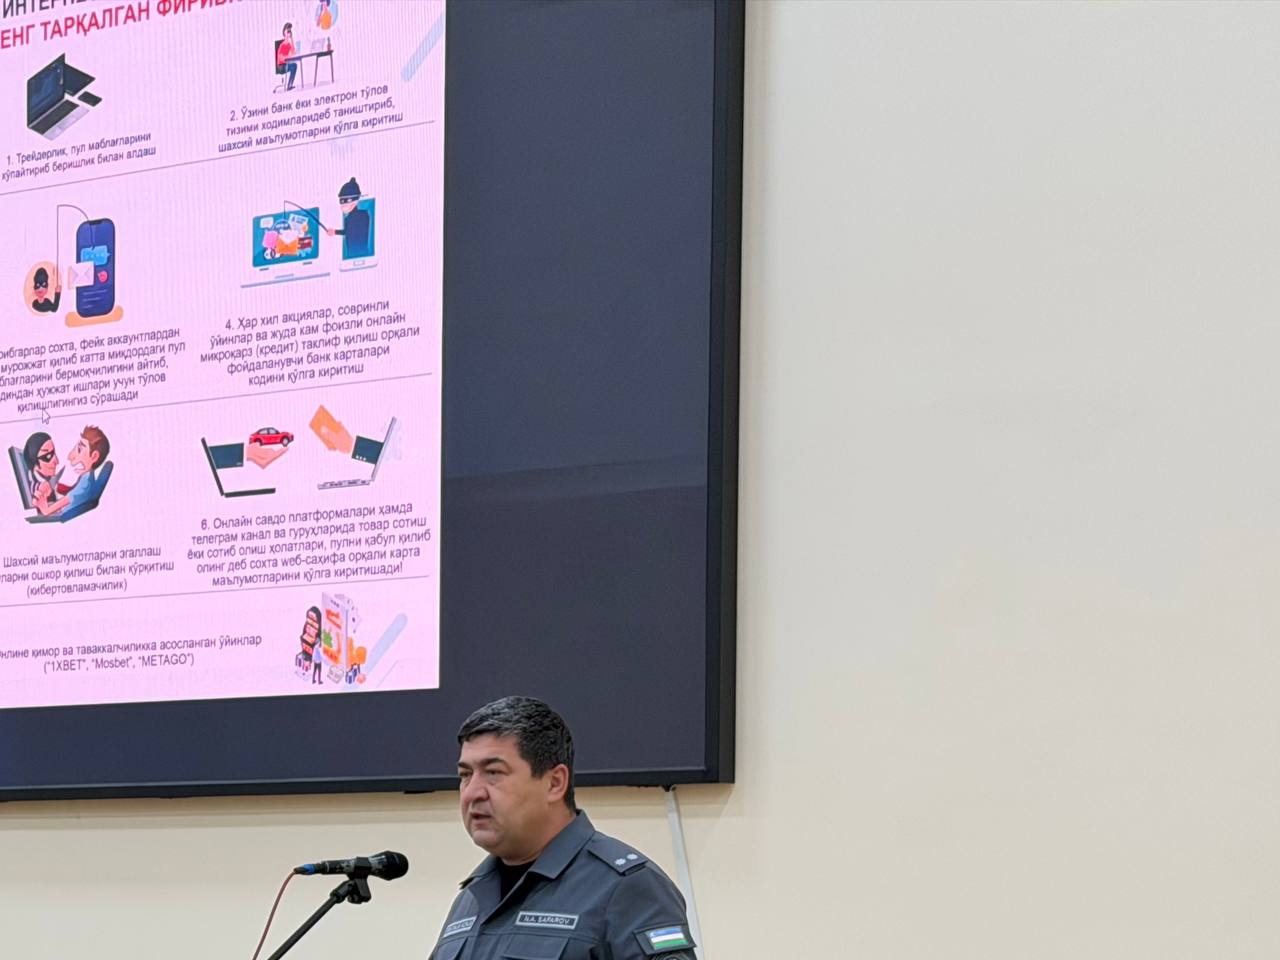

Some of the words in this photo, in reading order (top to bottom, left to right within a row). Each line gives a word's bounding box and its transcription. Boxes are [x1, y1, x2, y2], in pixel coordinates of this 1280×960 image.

[40, 1, 150, 41] ТАРҚАЛГАН
[229, 109, 238, 121] 2.
[240, 105, 268, 119] Ўзини
[271, 102, 293, 113] банк
[314, 90, 357, 106] электрон
[360, 84, 388, 99] тўлов
[218, 136, 252, 152] шахсий
[255, 125, 330, 145] маълумотларни
[333, 120, 358, 134] қўлга
[361, 112, 403, 128] киритиш
[225, 123, 259, 136] тизими
[261, 107, 330, 130] ходимларидеб
[6, 154, 13, 165] 1.
[70, 143, 86, 155] пул
[97, 152, 124, 164] билан
[126, 146, 156, 159] алдаш
[224, 318, 234, 330] 4.
[236, 316, 257, 330] Ҳар
[260, 314, 278, 326] хил
[337, 300, 389, 316] совринли
[255, 330, 267, 341] ва
[270, 327, 296, 341] жуда
[299, 324, 319, 335] кам
[322, 318, 363, 334] фоизли
[365, 311, 405, 327] онлайн
[79, 335, 104, 351] фейк
[106, 328, 180, 345] аккаунтлардан
[79, 351, 105, 363] катта
[167, 341, 185, 354] пул
[200, 347, 252, 363] микроқарз
[255, 339, 298, 358] (кредит)
[301, 334, 340, 349] таклиф
[343, 332, 378, 346] қилиш
[380, 326, 420, 341] орқали
[226, 356, 303, 375] фойдаланувчи
[306, 351, 331, 364] банк
[333, 345, 390, 361] карталари
[72, 379, 110, 392] ишлари
[112, 376, 135, 390] учун
[137, 372, 166, 386] тўлов
[248, 373, 284, 386] кодини
[287, 368, 315, 383] қўлга
[318, 363, 363, 379] киритиш
[200, 518, 210, 530] 6.
[213, 515, 252, 529] Онлайн
[255, 513, 286, 525] савдо
[288, 506, 375, 522] платформалари
[378, 502, 412, 515] ҳамда
[191, 533, 238, 545] телеграм
[240, 529, 271, 541] канал
[273, 528, 286, 538] ва
[358, 519, 389, 531] товар
[392, 517, 426, 528] сотиш
[3, 554, 39, 567] Шахсий
[41, 550, 117, 565] маълумотларни
[119, 547, 161, 558] эгаллаш
[206, 544, 236, 558] сотиб
[238, 544, 266, 555] олиш
[330, 537, 362, 550] пулни
[364, 532, 395, 547] қабул
[31, 569, 61, 581] ошкор
[63, 567, 93, 579] қилиш
[95, 564, 125, 575] билан
[196, 562, 225, 573] олинг
[226, 558, 247, 572] деб
[249, 558, 278, 569] сохта
[348, 550, 386, 563] орқали
[389, 546, 420, 560] карта
[211, 571, 300, 587] маълумотларини
[303, 567, 331, 582] қўлга
[333, 561, 402, 579] киритишади!
[26, 578, 127, 597] (кибертовламачилик)
[62, 646, 73, 656] ва
[159, 638, 216, 650] асосланган
